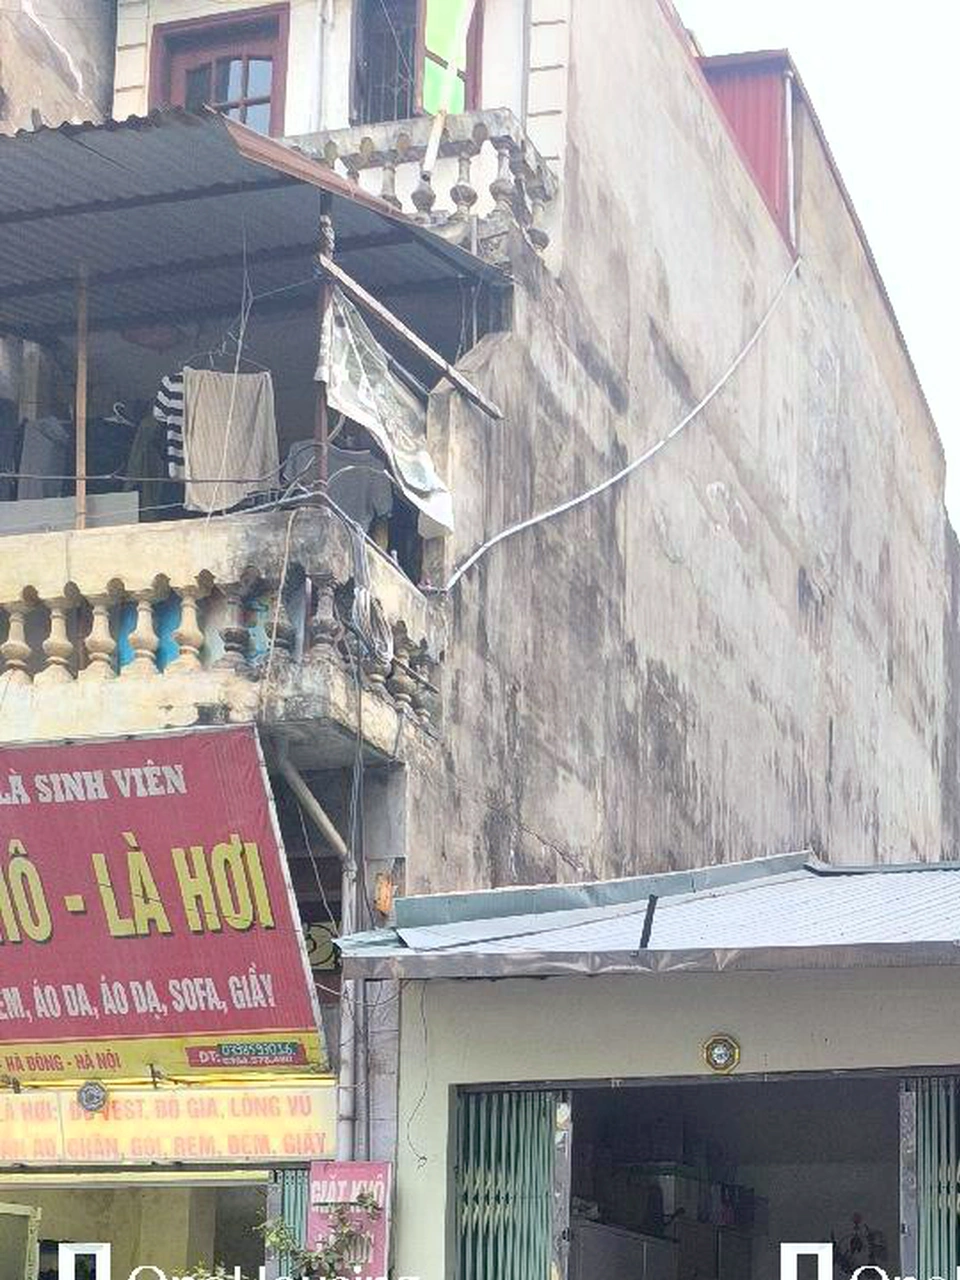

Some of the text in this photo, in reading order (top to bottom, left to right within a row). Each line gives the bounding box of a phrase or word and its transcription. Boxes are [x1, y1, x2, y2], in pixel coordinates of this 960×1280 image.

[34, 770, 109, 803] SINH
[111, 758, 188, 798] VIÊN
[91, 831, 173, 937] LÀ
[171, 833, 275, 932] HƠI
[33, 978, 61, 1019] ÁO
[62, 982, 99, 1020] DA,
[100, 974, 129, 1015] ÁO
[168, 977, 228, 1015] SOFA,
